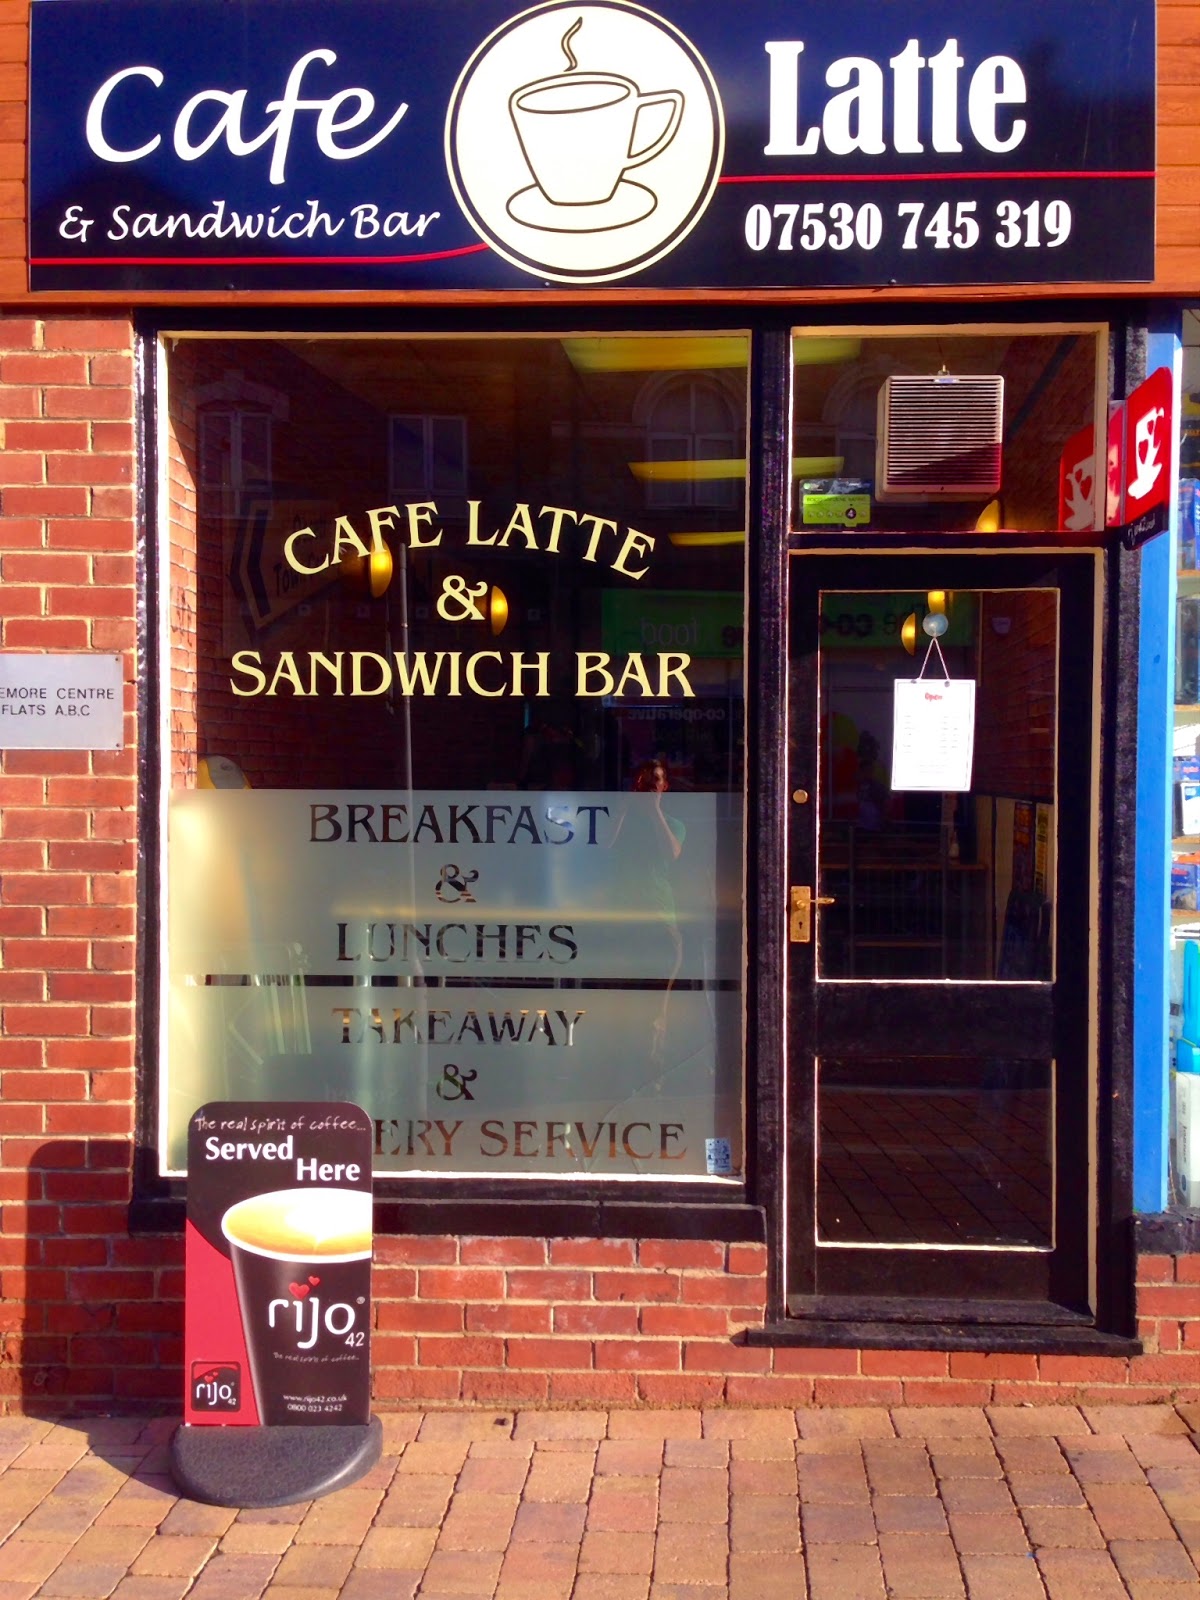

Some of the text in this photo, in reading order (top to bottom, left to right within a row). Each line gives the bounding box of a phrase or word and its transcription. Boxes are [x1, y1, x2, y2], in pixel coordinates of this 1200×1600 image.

[86, 49, 408, 184] Cafe
[763, 38, 1027, 156] Latte
[58, 200, 440, 242] & Sandwich Bar
[745, 200, 1071, 251] 07530 745 319
[284, 501, 444, 575] CAFE
[467, 500, 656, 580] LATTE
[436, 574, 489, 621] &
[56, 687, 115, 700] CENTRE
[230, 650, 696, 697] SANDWICH BAR
[1, 704, 46, 716] FLATS
[308, 803, 610, 846] BREAKFAST
[435, 863, 480, 903] &
[336, 922, 579, 964] LUNCHES
[332, 1007, 588, 1047] TAKEAWAY
[436, 1063, 478, 1101] &
[195, 1115, 216, 1132] The
[220, 1117, 247, 1132] real
[250, 1118, 286, 1134] spirit
[290, 1116, 305, 1131] of
[480, 1119, 687, 1160] SERVICE
[205, 1135, 294, 1161] Served
[296, 1157, 361, 1182] Here
[345, 1331, 365, 1348] 42
